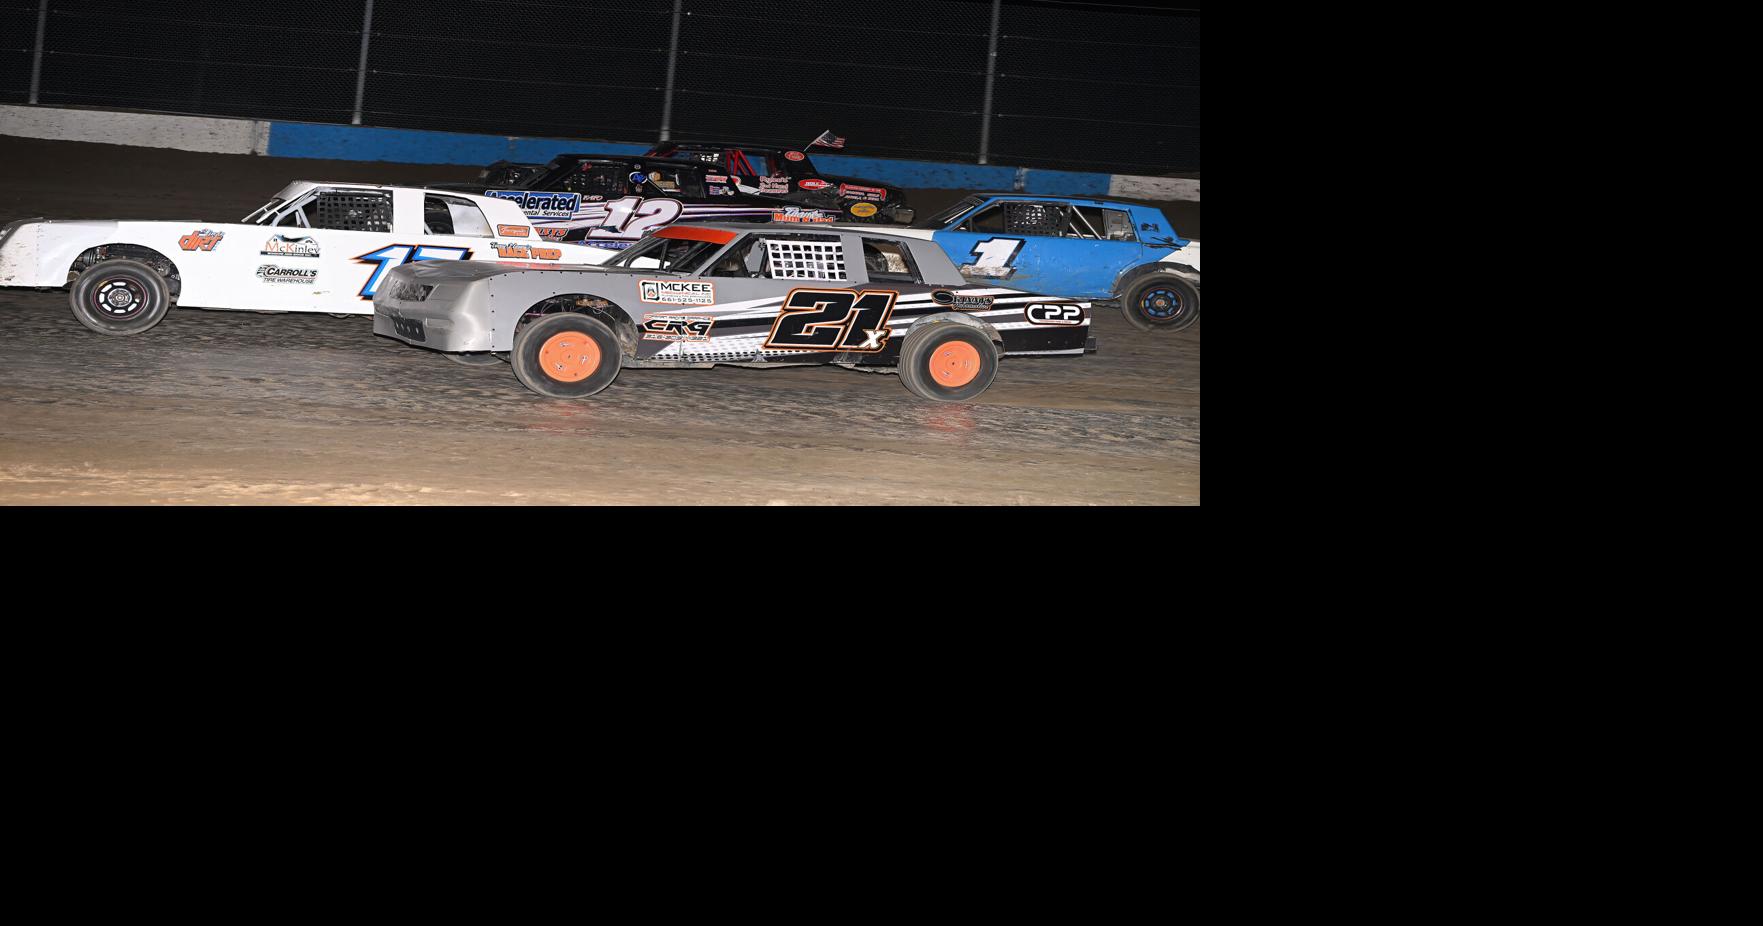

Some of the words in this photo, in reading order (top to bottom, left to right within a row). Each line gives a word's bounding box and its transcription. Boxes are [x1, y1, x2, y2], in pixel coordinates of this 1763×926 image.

[585, 196, 684, 241] 12
[265, 240, 320, 254] McKinley
[960, 236, 1026, 280] 1
[267, 267, 318, 277] CARROLL'S
[660, 282, 711, 292] MCKEE
[1027, 304, 1081, 324] CPP
